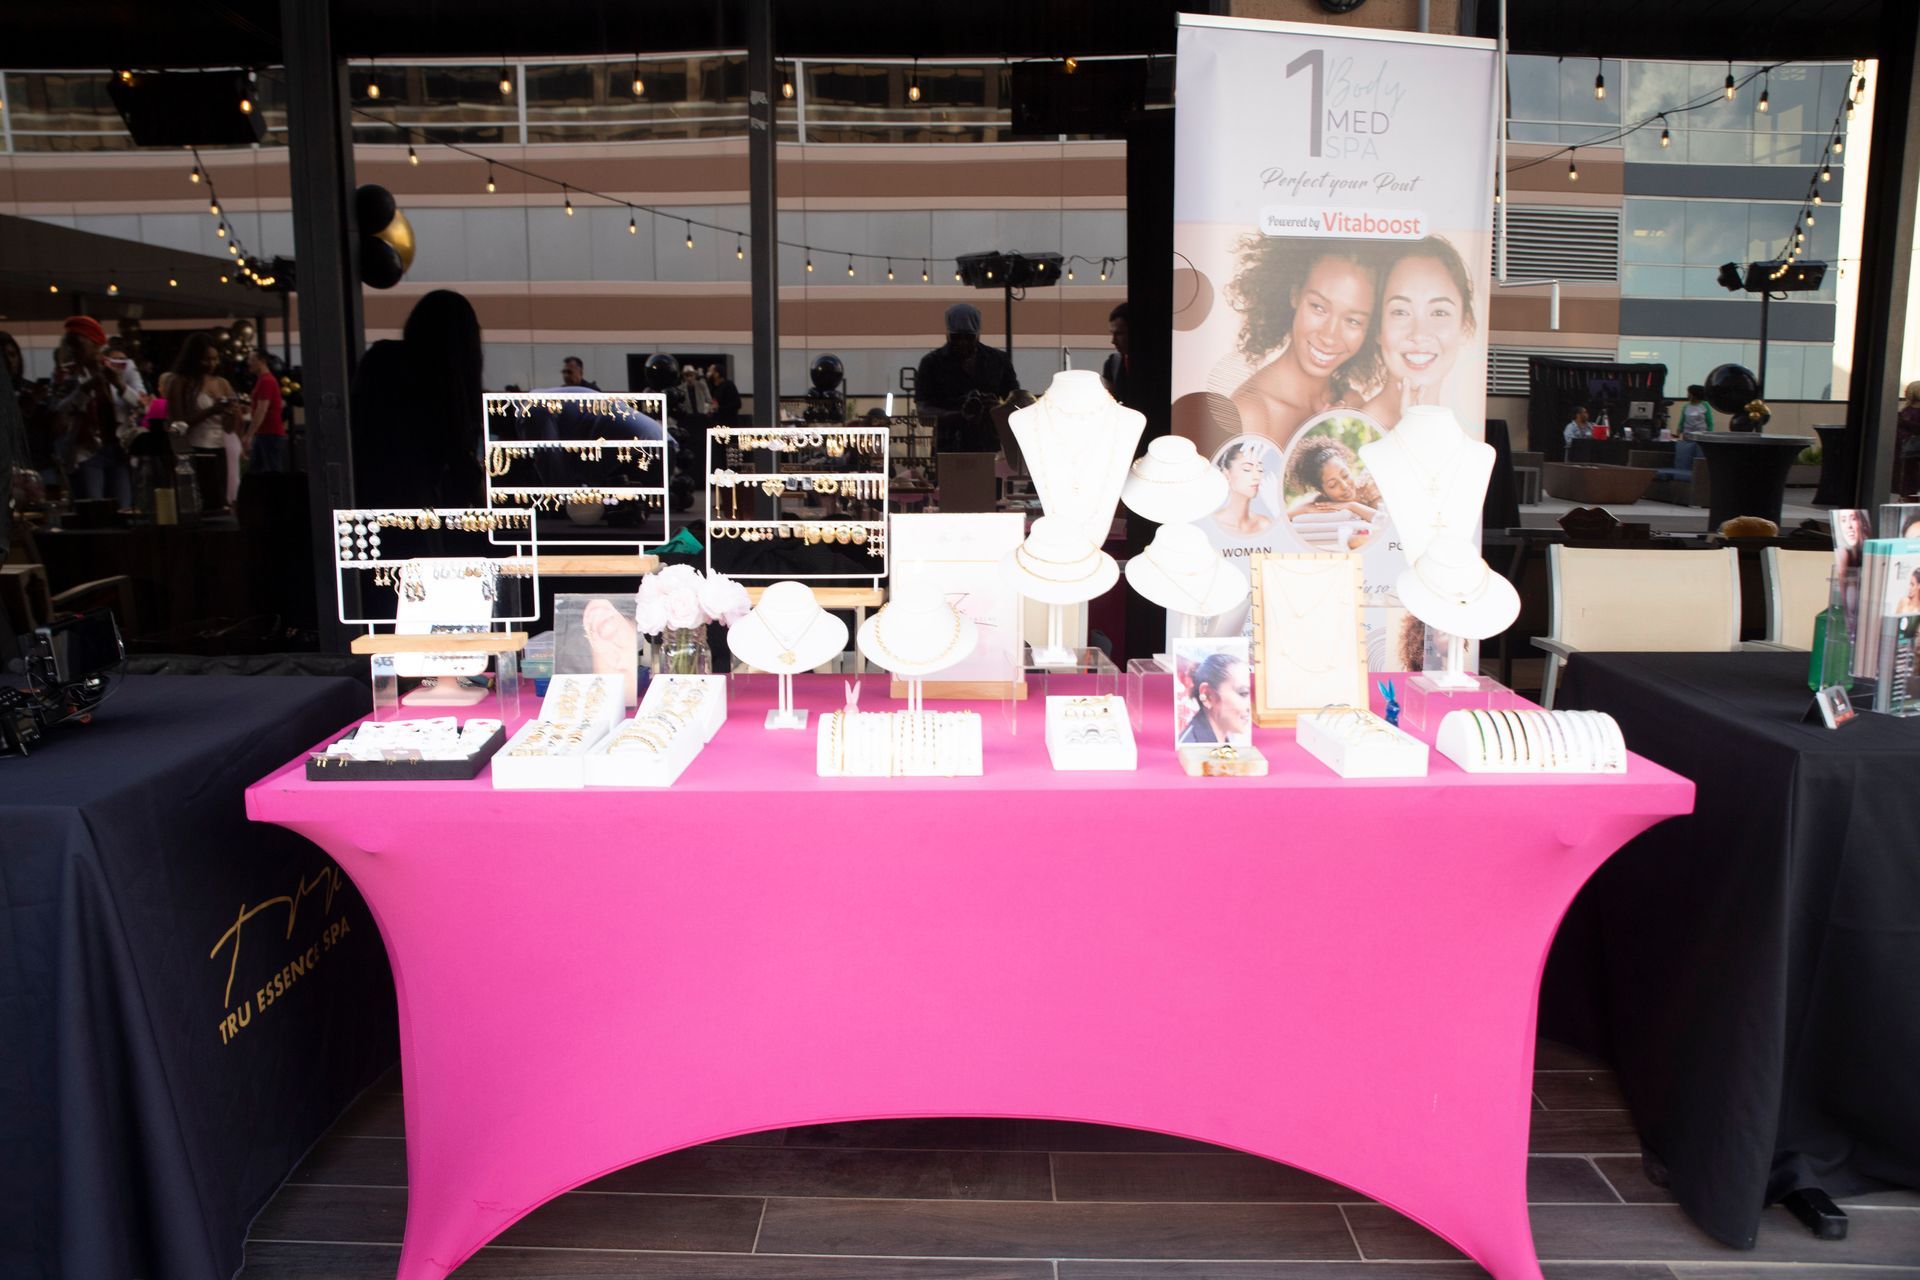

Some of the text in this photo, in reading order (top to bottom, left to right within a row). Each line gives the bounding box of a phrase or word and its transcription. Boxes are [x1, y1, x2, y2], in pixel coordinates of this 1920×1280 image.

[1325, 56, 1407, 117] Body
[1286, 49, 1324, 157] 1
[1326, 109, 1390, 134] MED
[1325, 135, 1380, 161] SPA
[1259, 167, 1425, 198] Perfect your Pout
[1267, 212, 1421, 235] Powered by Vitaboost
[218, 916, 351, 1045] TRU ESSENCE SPA
